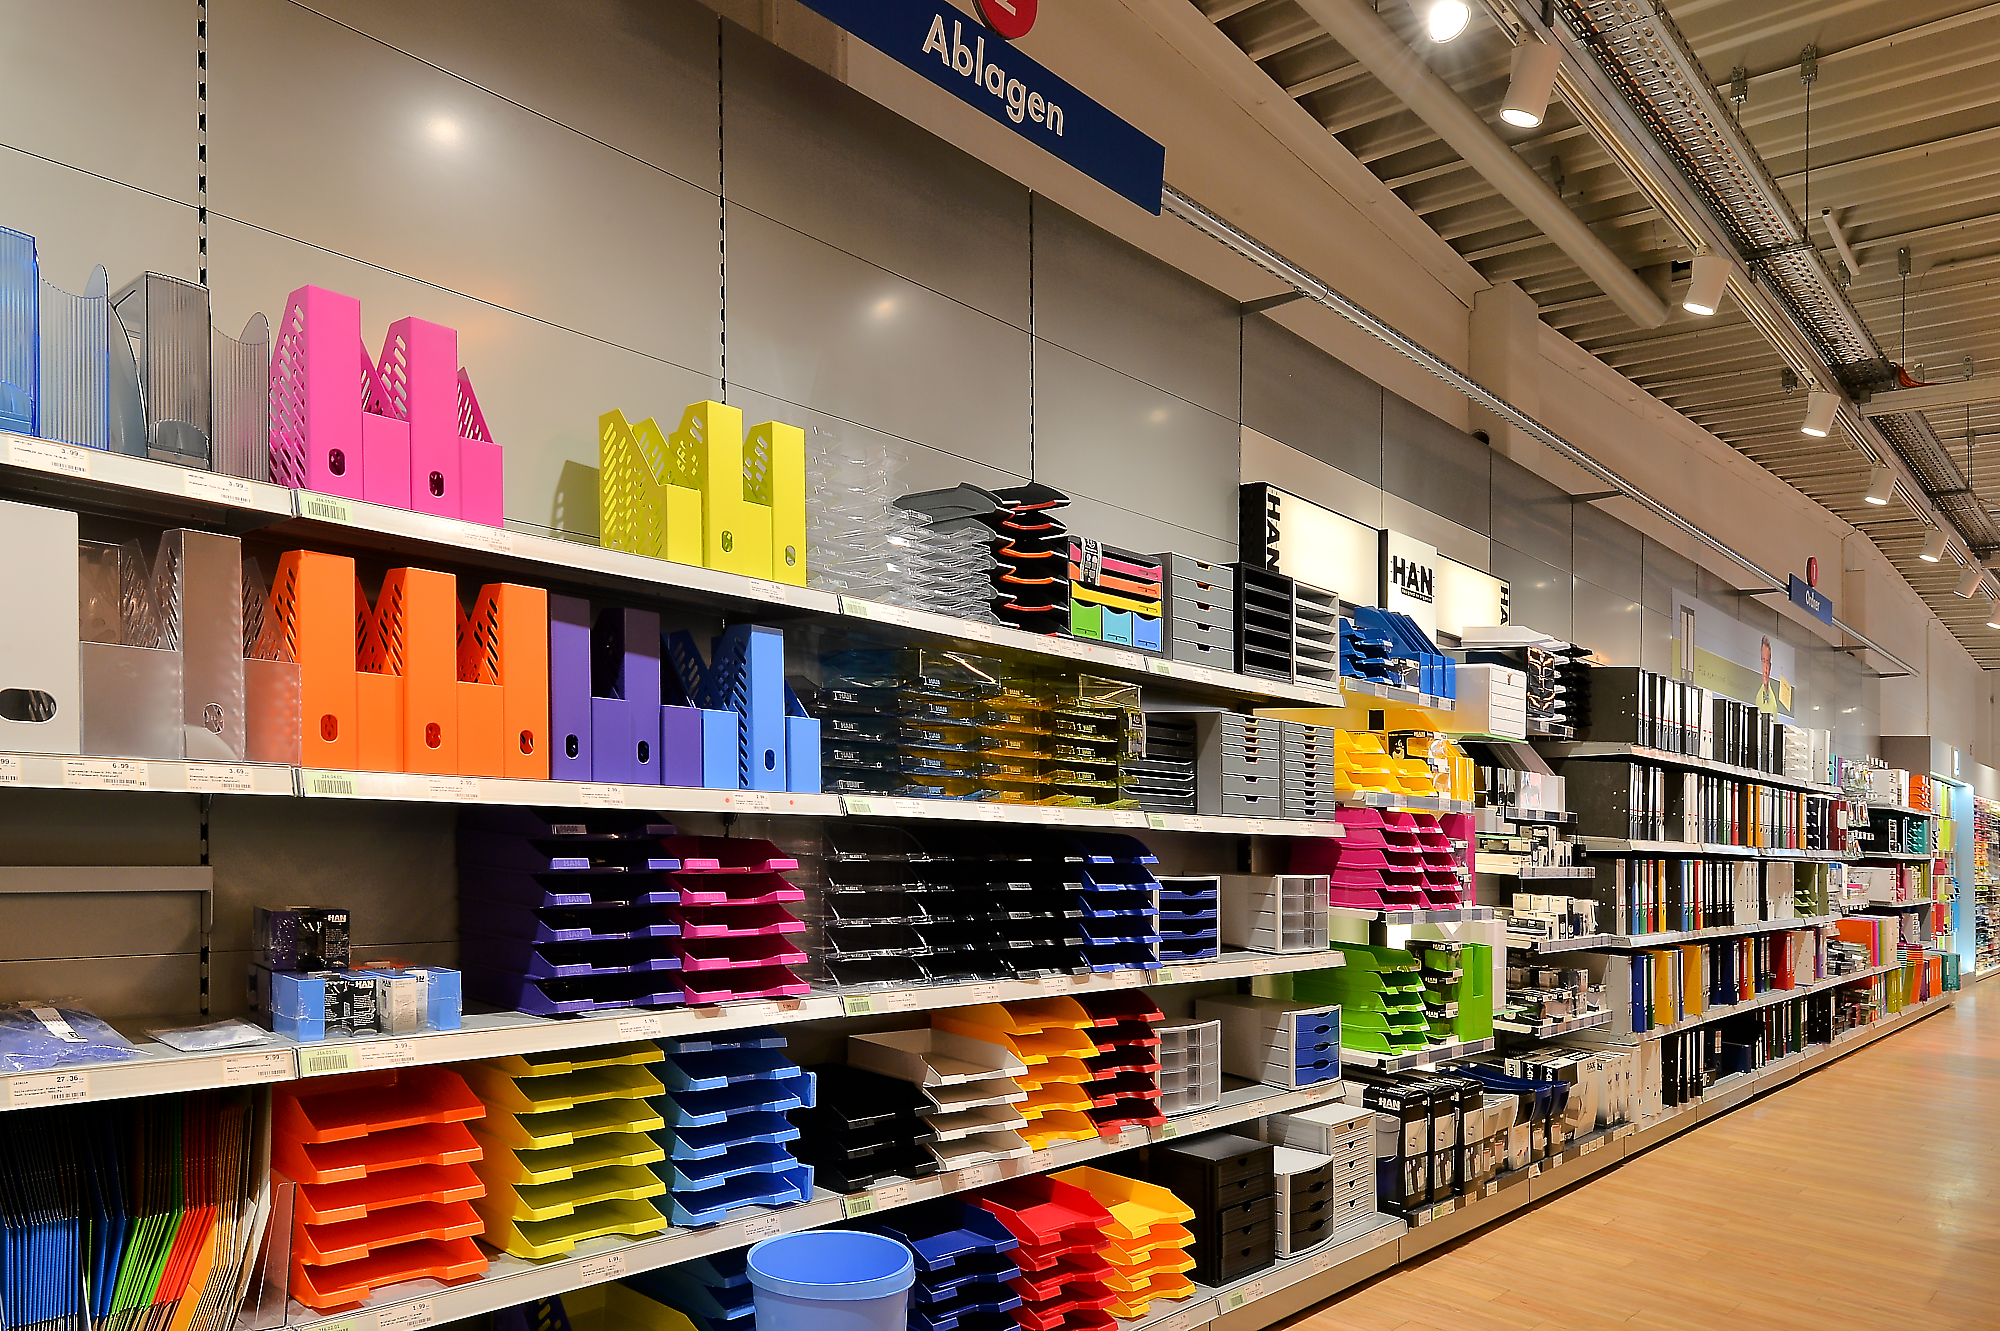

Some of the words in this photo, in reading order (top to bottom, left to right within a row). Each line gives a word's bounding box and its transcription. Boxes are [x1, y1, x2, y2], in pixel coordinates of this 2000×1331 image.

[922, 13, 1065, 137] Ablagen
[1267, 493, 1281, 572] HAN
[1392, 555, 1434, 595] HAN
[1500, 586, 1509, 626] HA
[1805, 590, 1821, 612] Ordner
[327, 914, 347, 923] HAN
[355, 979, 375, 989] HAN
[56, 1075, 79, 1083] 27.36
[1378, 1097, 1401, 1111] HAN
